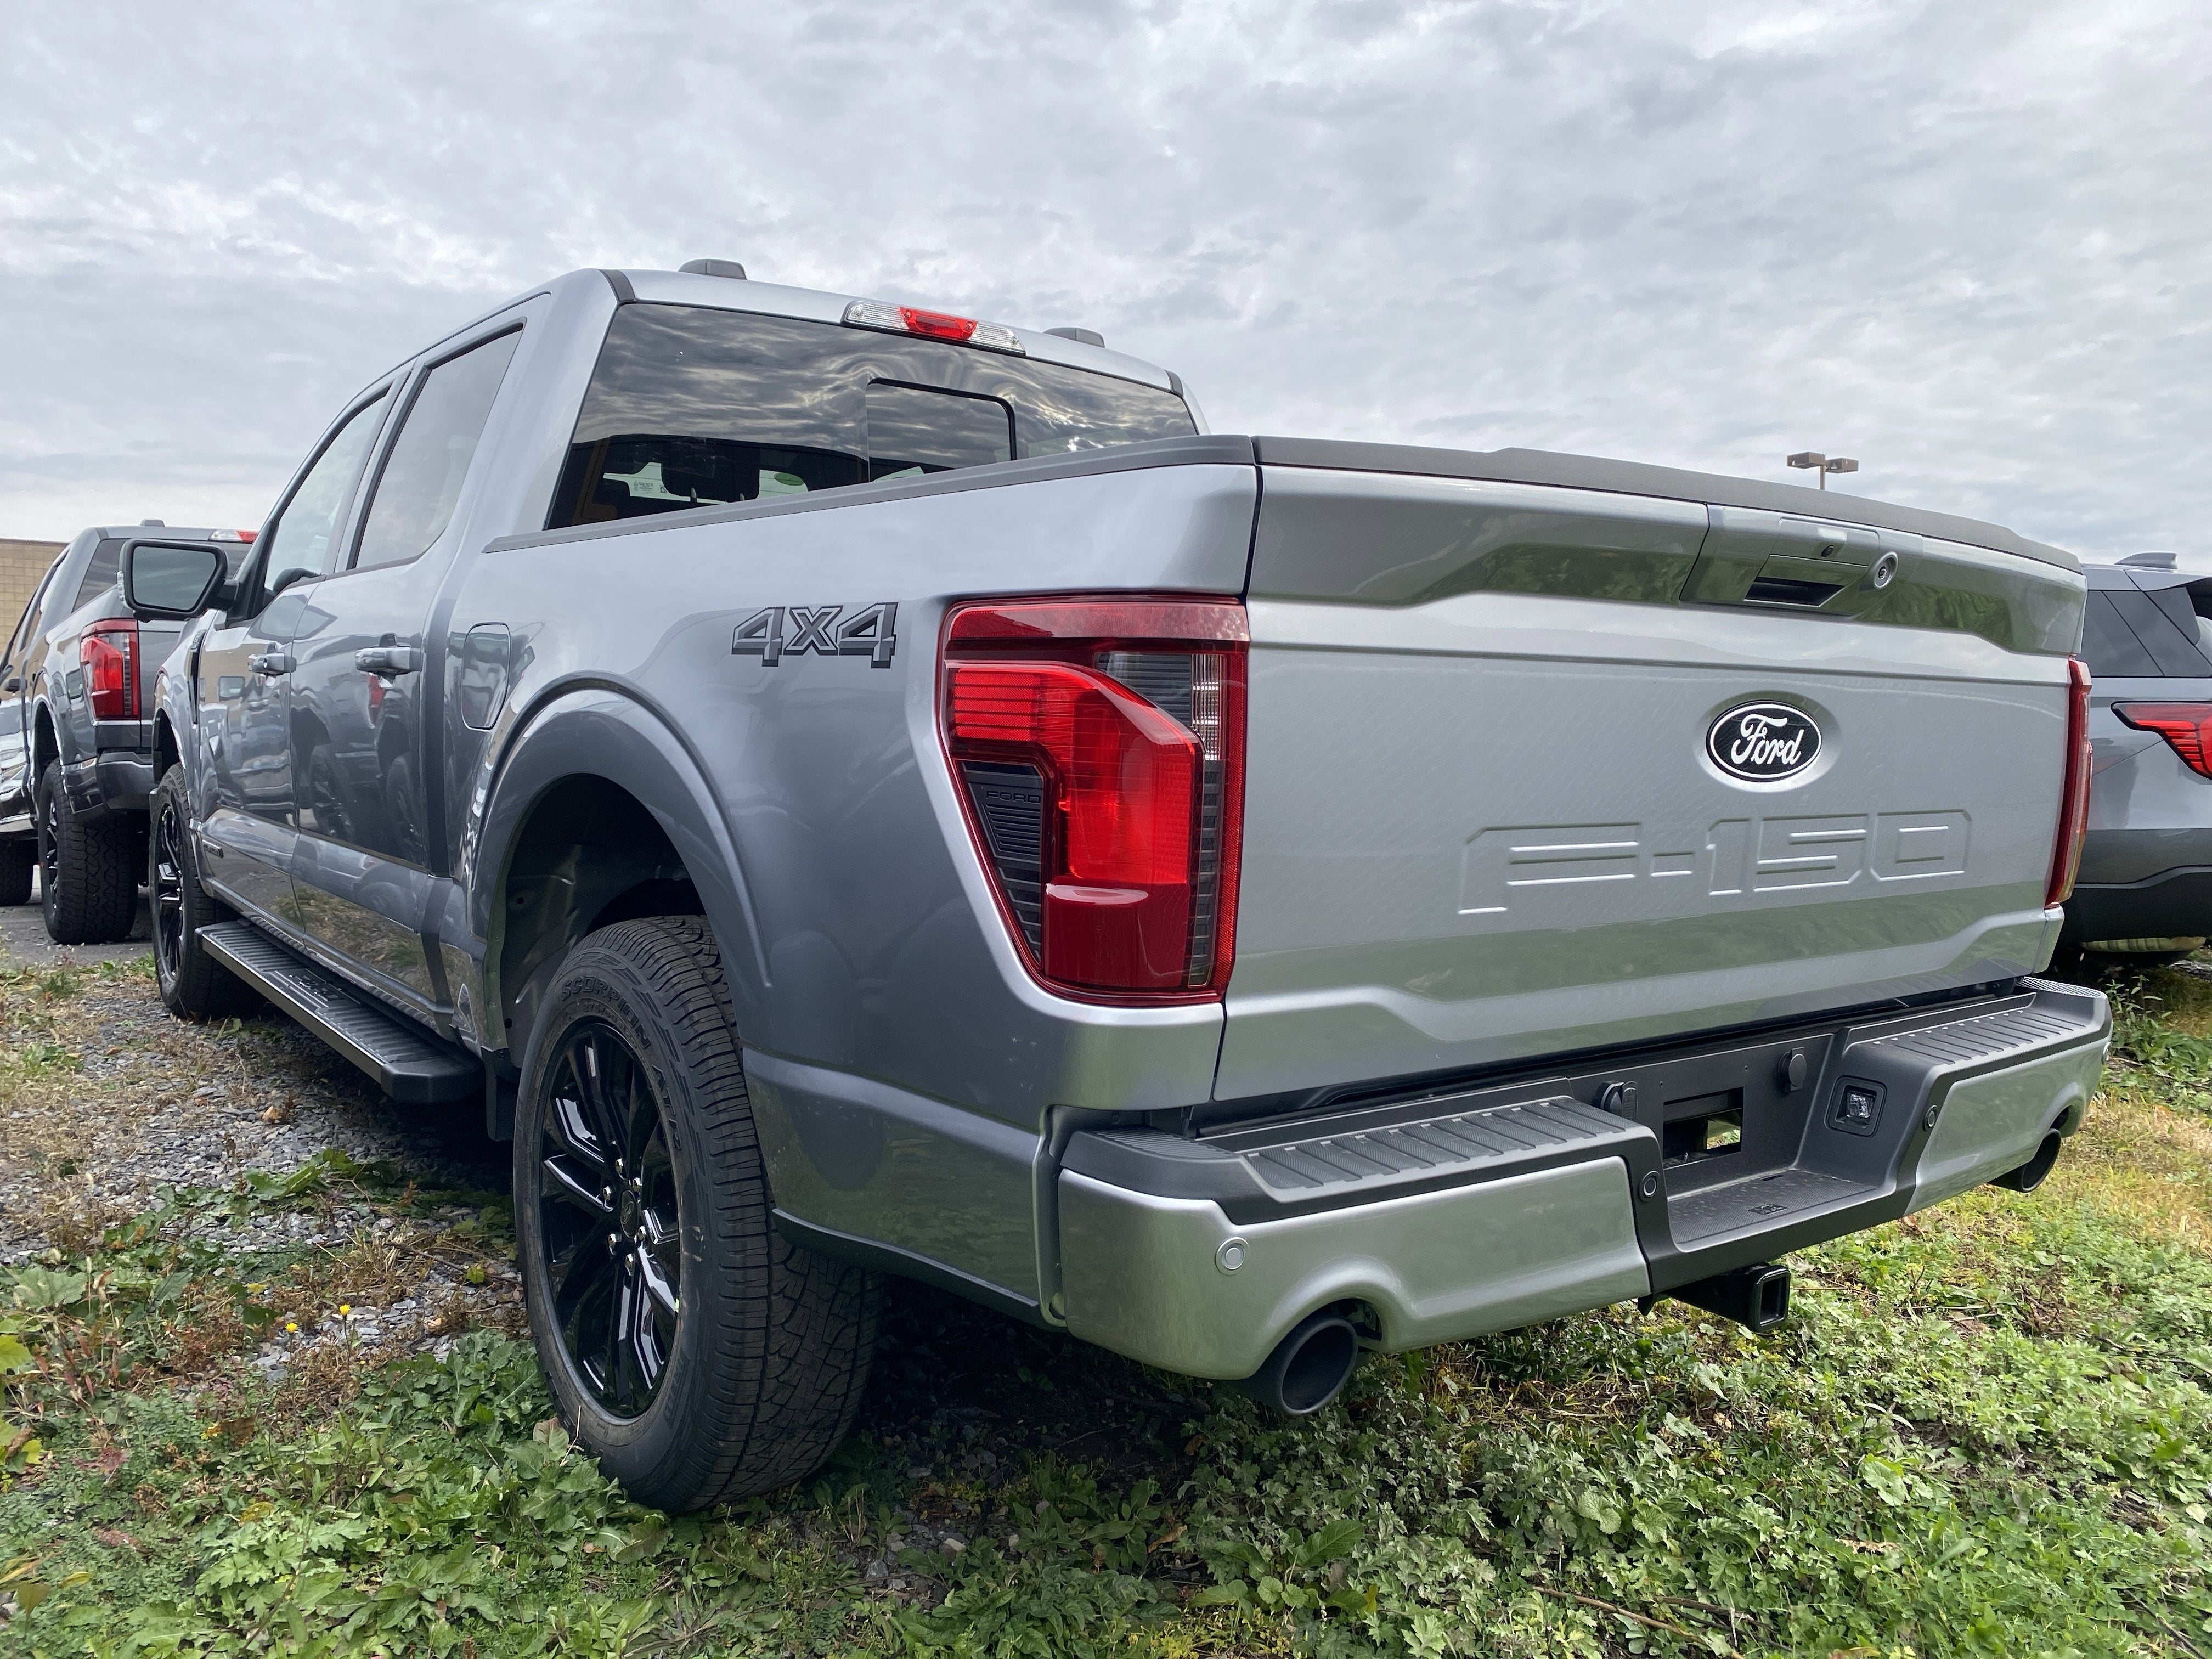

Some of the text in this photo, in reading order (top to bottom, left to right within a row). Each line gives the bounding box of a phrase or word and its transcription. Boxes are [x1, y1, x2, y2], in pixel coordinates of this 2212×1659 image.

[1730, 713, 1805, 765] Ford
[986, 791, 1041, 804] FORD
[1458, 808, 1972, 916] F-150
[561, 975, 682, 1150] SCORPION ATR
